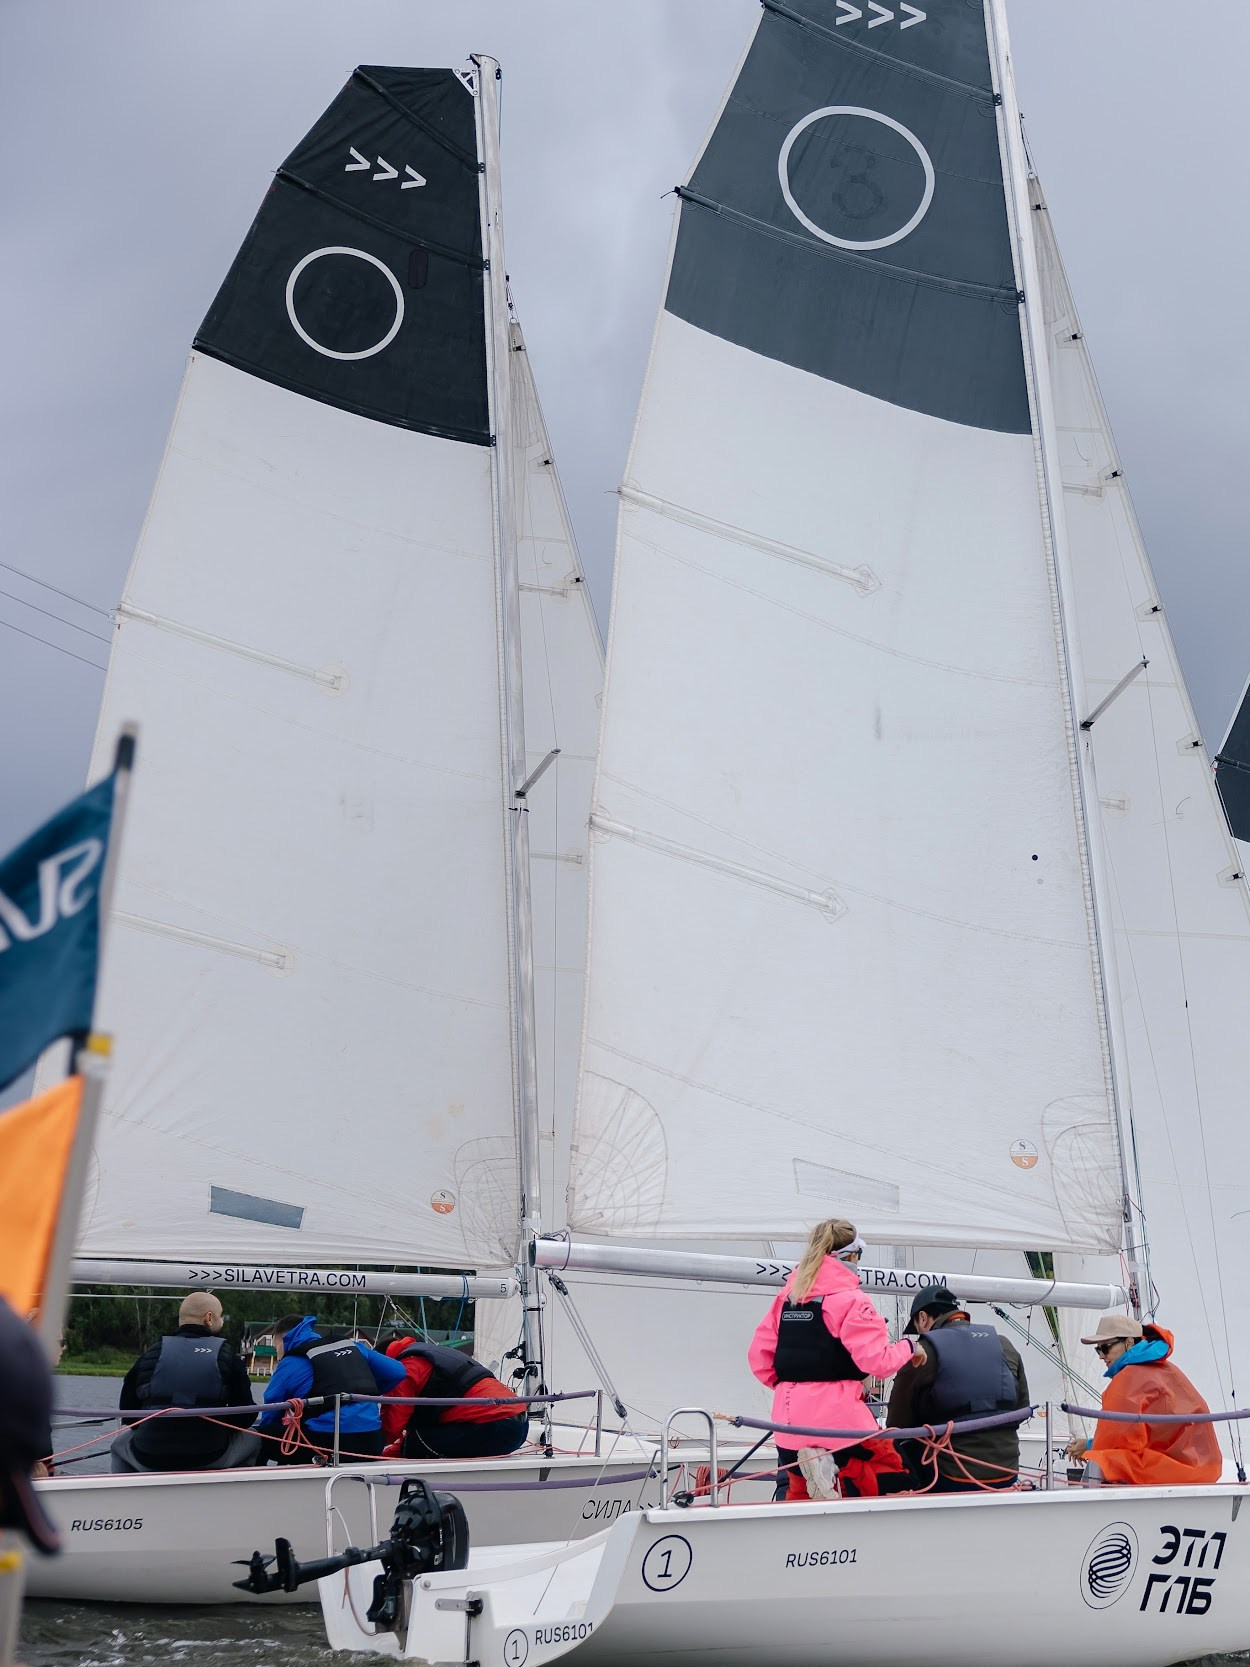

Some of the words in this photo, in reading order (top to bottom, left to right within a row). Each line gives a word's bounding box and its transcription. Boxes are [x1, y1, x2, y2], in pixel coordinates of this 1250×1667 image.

[500, 1283, 507, 1293] 5
[71, 1518, 144, 1532] RUS6105
[657, 1549, 672, 1578] 1
[785, 1548, 857, 1568] RUS6101
[511, 1639, 520, 1660] 1
